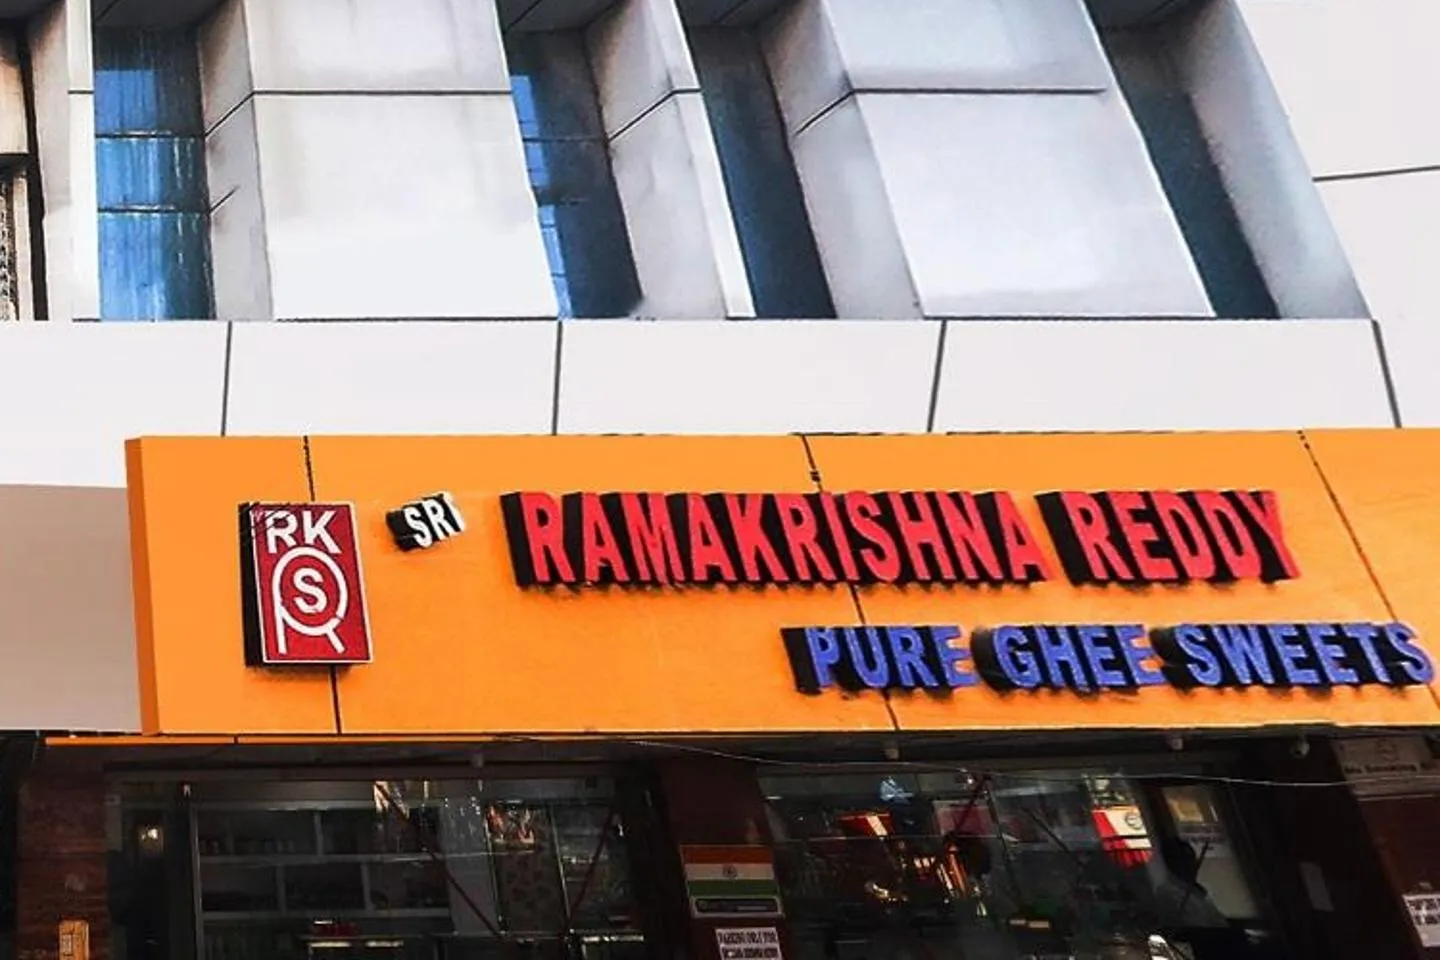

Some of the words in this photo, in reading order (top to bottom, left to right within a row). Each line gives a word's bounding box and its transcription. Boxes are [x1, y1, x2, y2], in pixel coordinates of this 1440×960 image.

[263, 508, 343, 555] RK
[396, 491, 467, 549] SRI
[506, 490, 1055, 585] RAMAKRISHNA
[1042, 489, 1302, 583] REDDY
[786, 624, 979, 692] PURE
[974, 623, 1168, 692] GHEE
[1162, 620, 1438, 688] SWEETS
